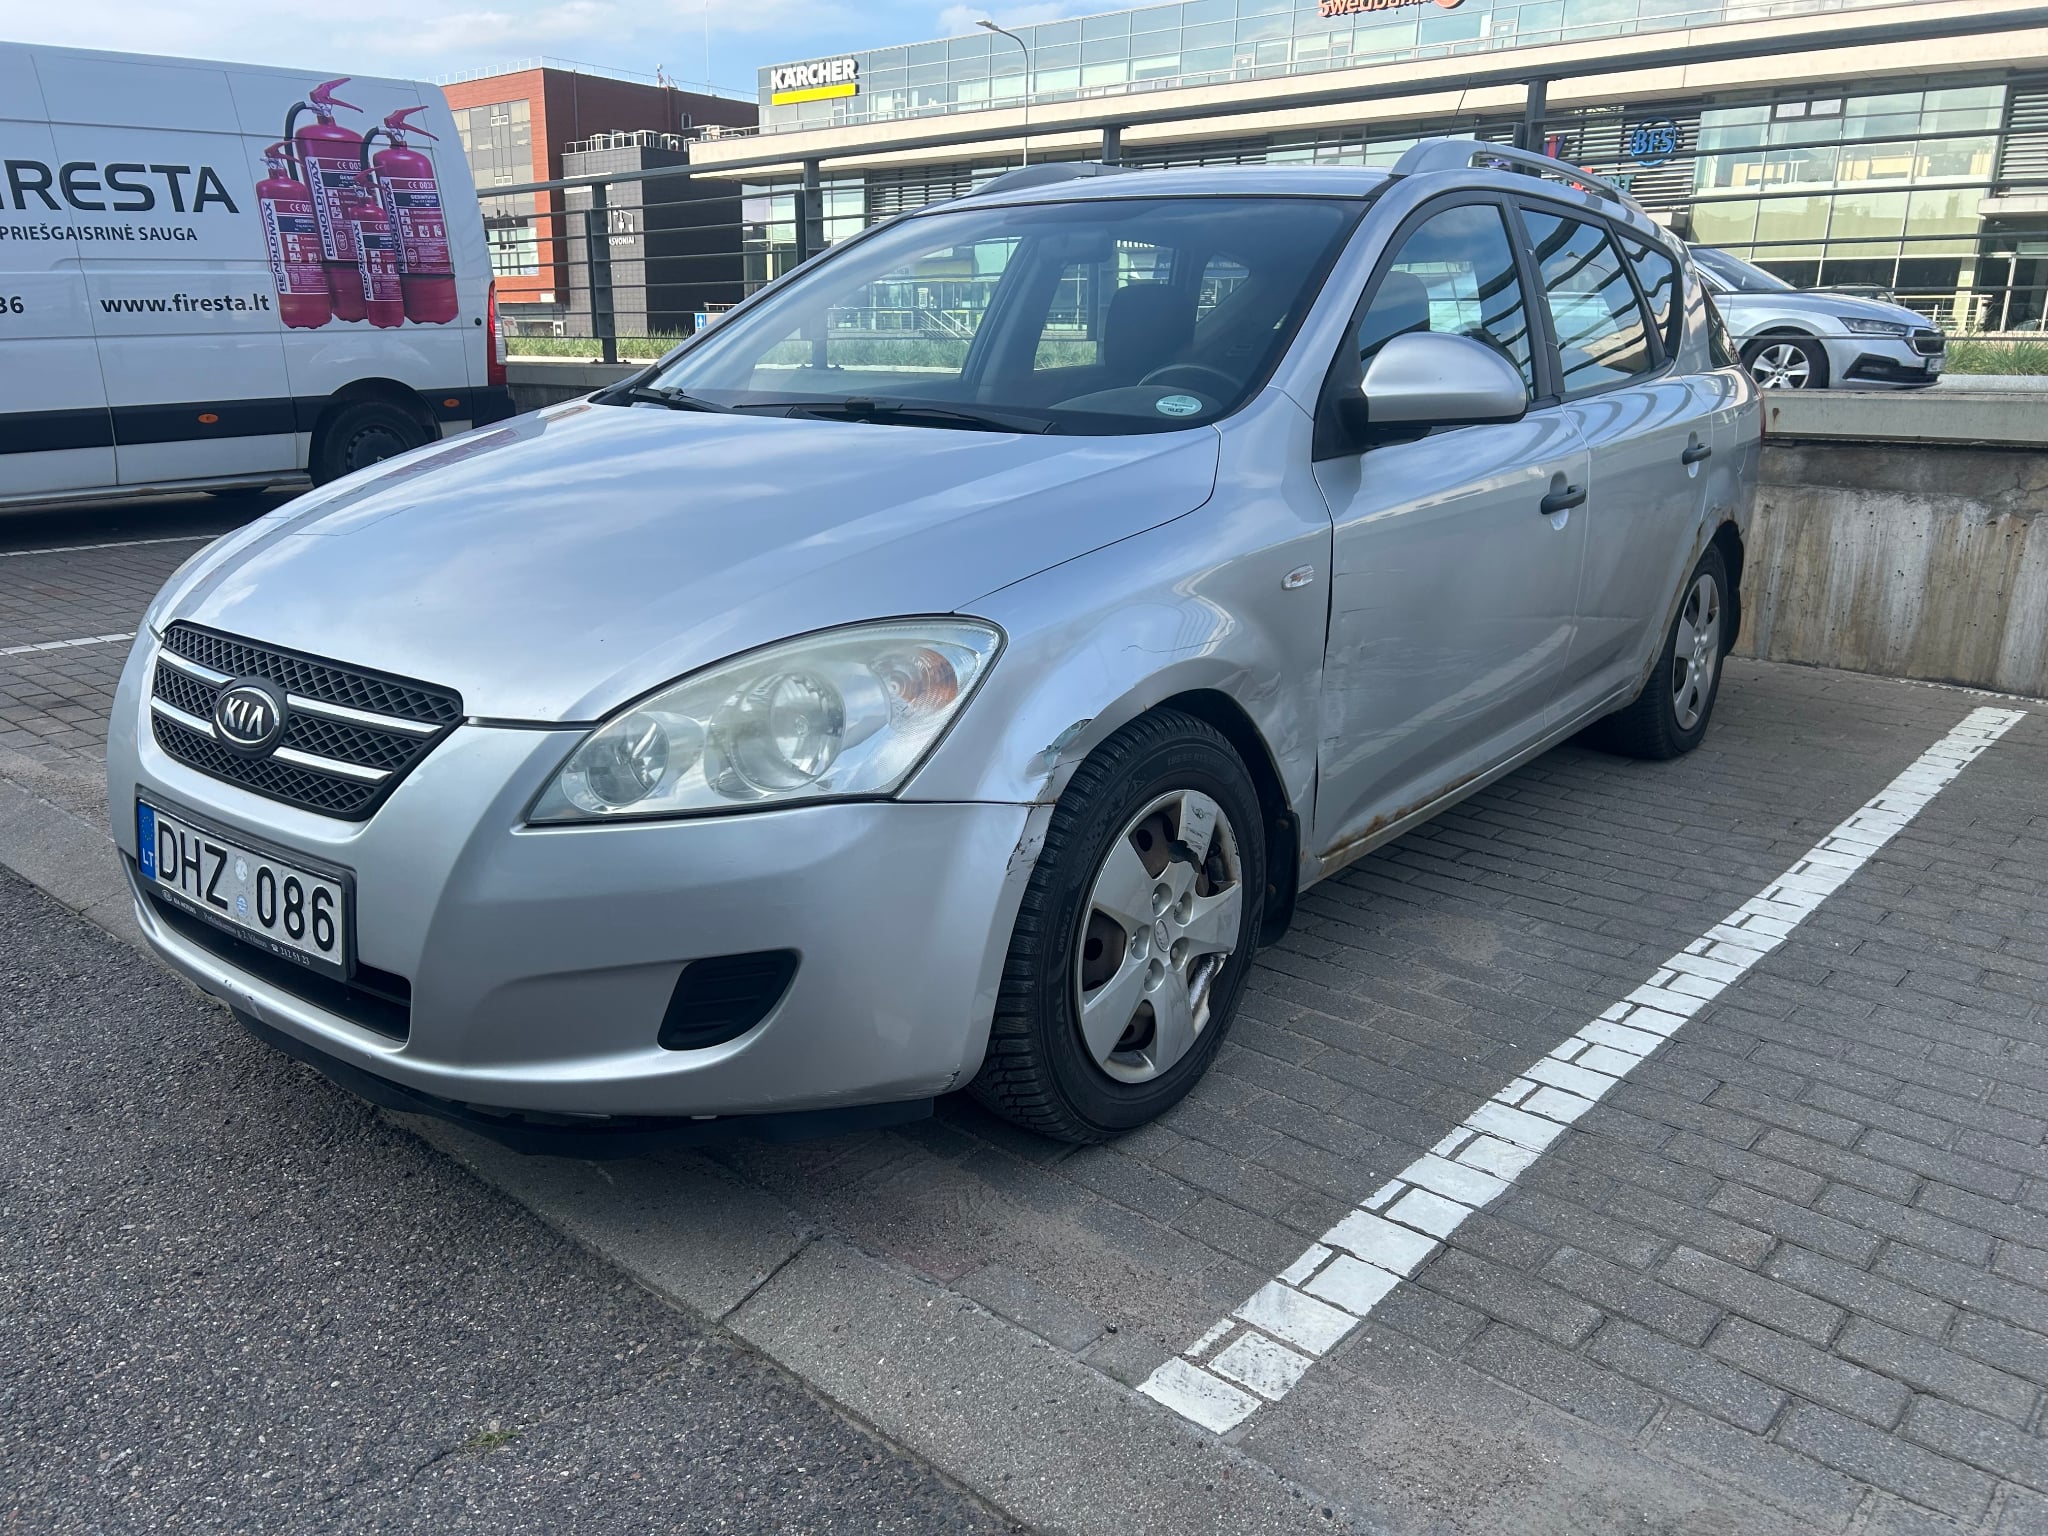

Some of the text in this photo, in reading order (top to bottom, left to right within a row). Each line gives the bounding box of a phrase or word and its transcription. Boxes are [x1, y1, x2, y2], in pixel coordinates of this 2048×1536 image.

[771, 59, 856, 90] KÄRCHER
[1635, 129, 1673, 154] BFS
[0, 160, 240, 214] RESTA
[0, 223, 198, 241] PRIEŠGAISRINĖ SAUGA
[100, 293, 270, 313] www.firesta.lt
[223, 697, 264, 737] KIA
[142, 848, 154, 867] LT
[157, 818, 335, 952] DHZ 086
